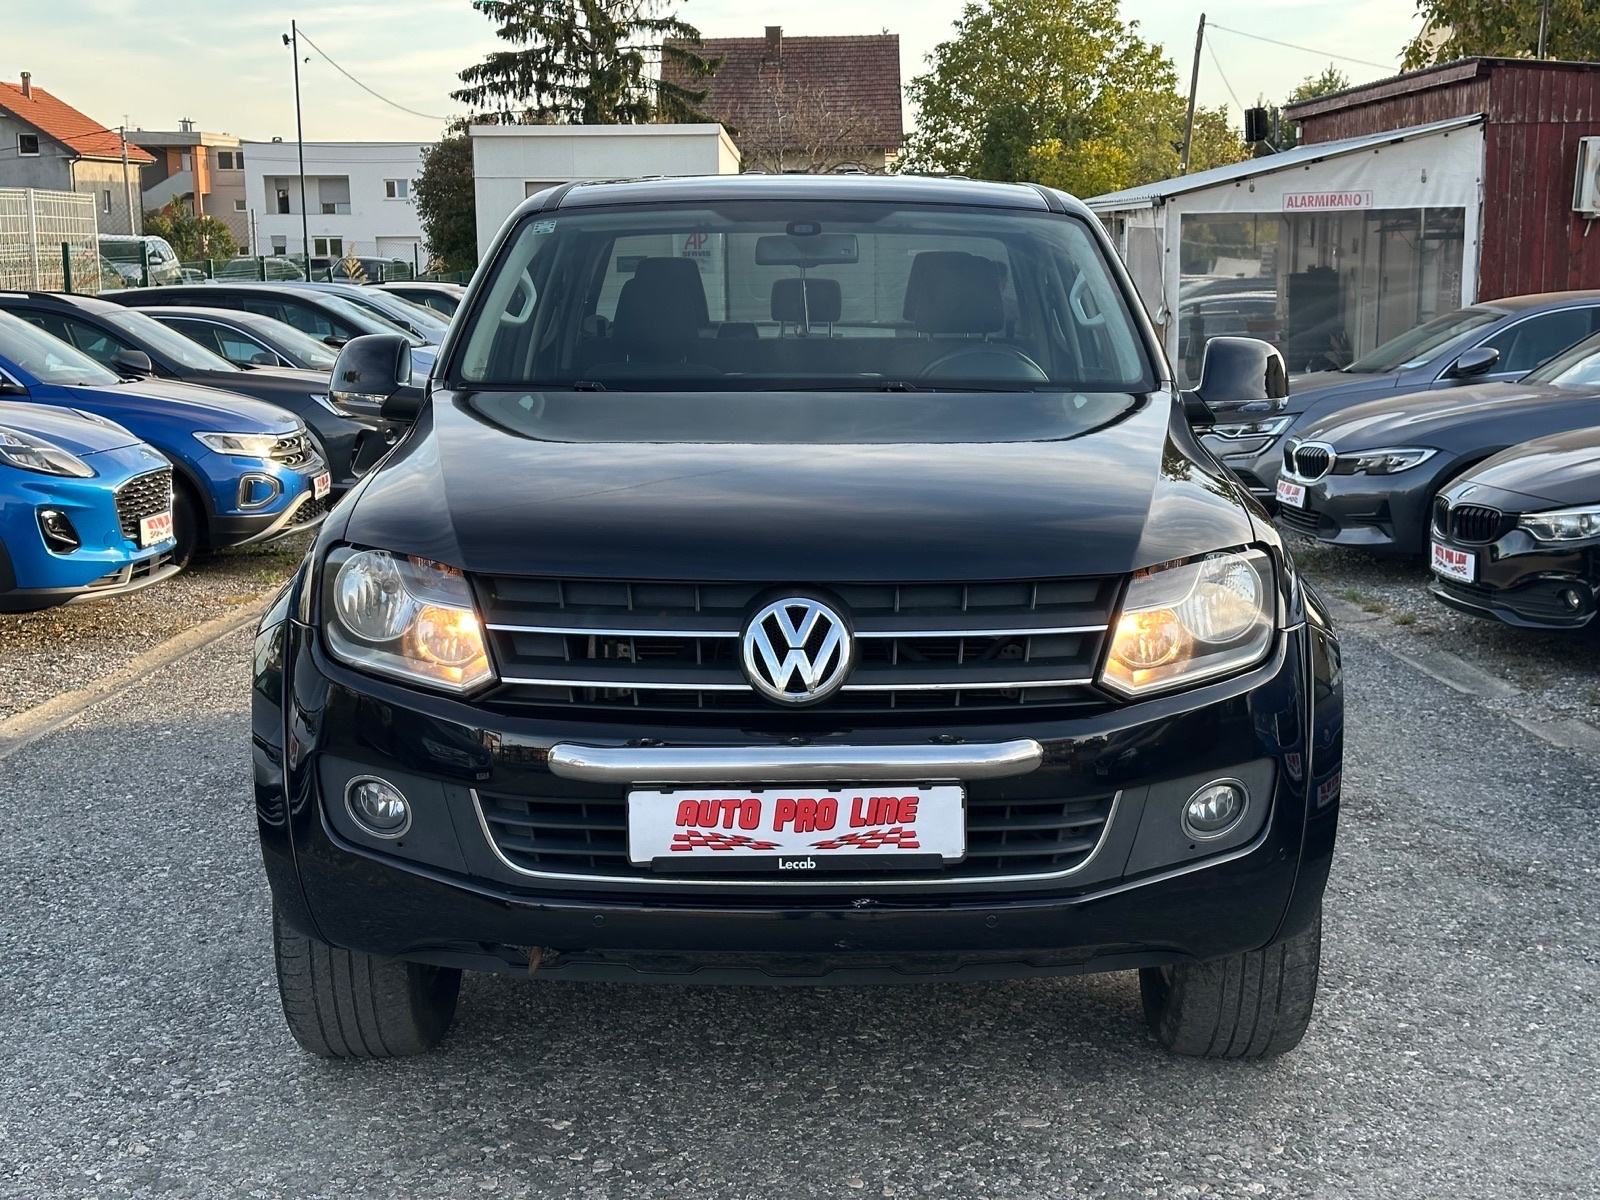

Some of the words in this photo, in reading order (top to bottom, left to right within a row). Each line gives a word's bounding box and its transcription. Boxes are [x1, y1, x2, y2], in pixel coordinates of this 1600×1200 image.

[1287, 194, 1361, 208] ALARMIRANO
[676, 799, 761, 830] AUTO
[773, 798, 838, 833] PRO
[849, 796, 919, 827] LINE
[778, 857, 816, 870] Lecab
